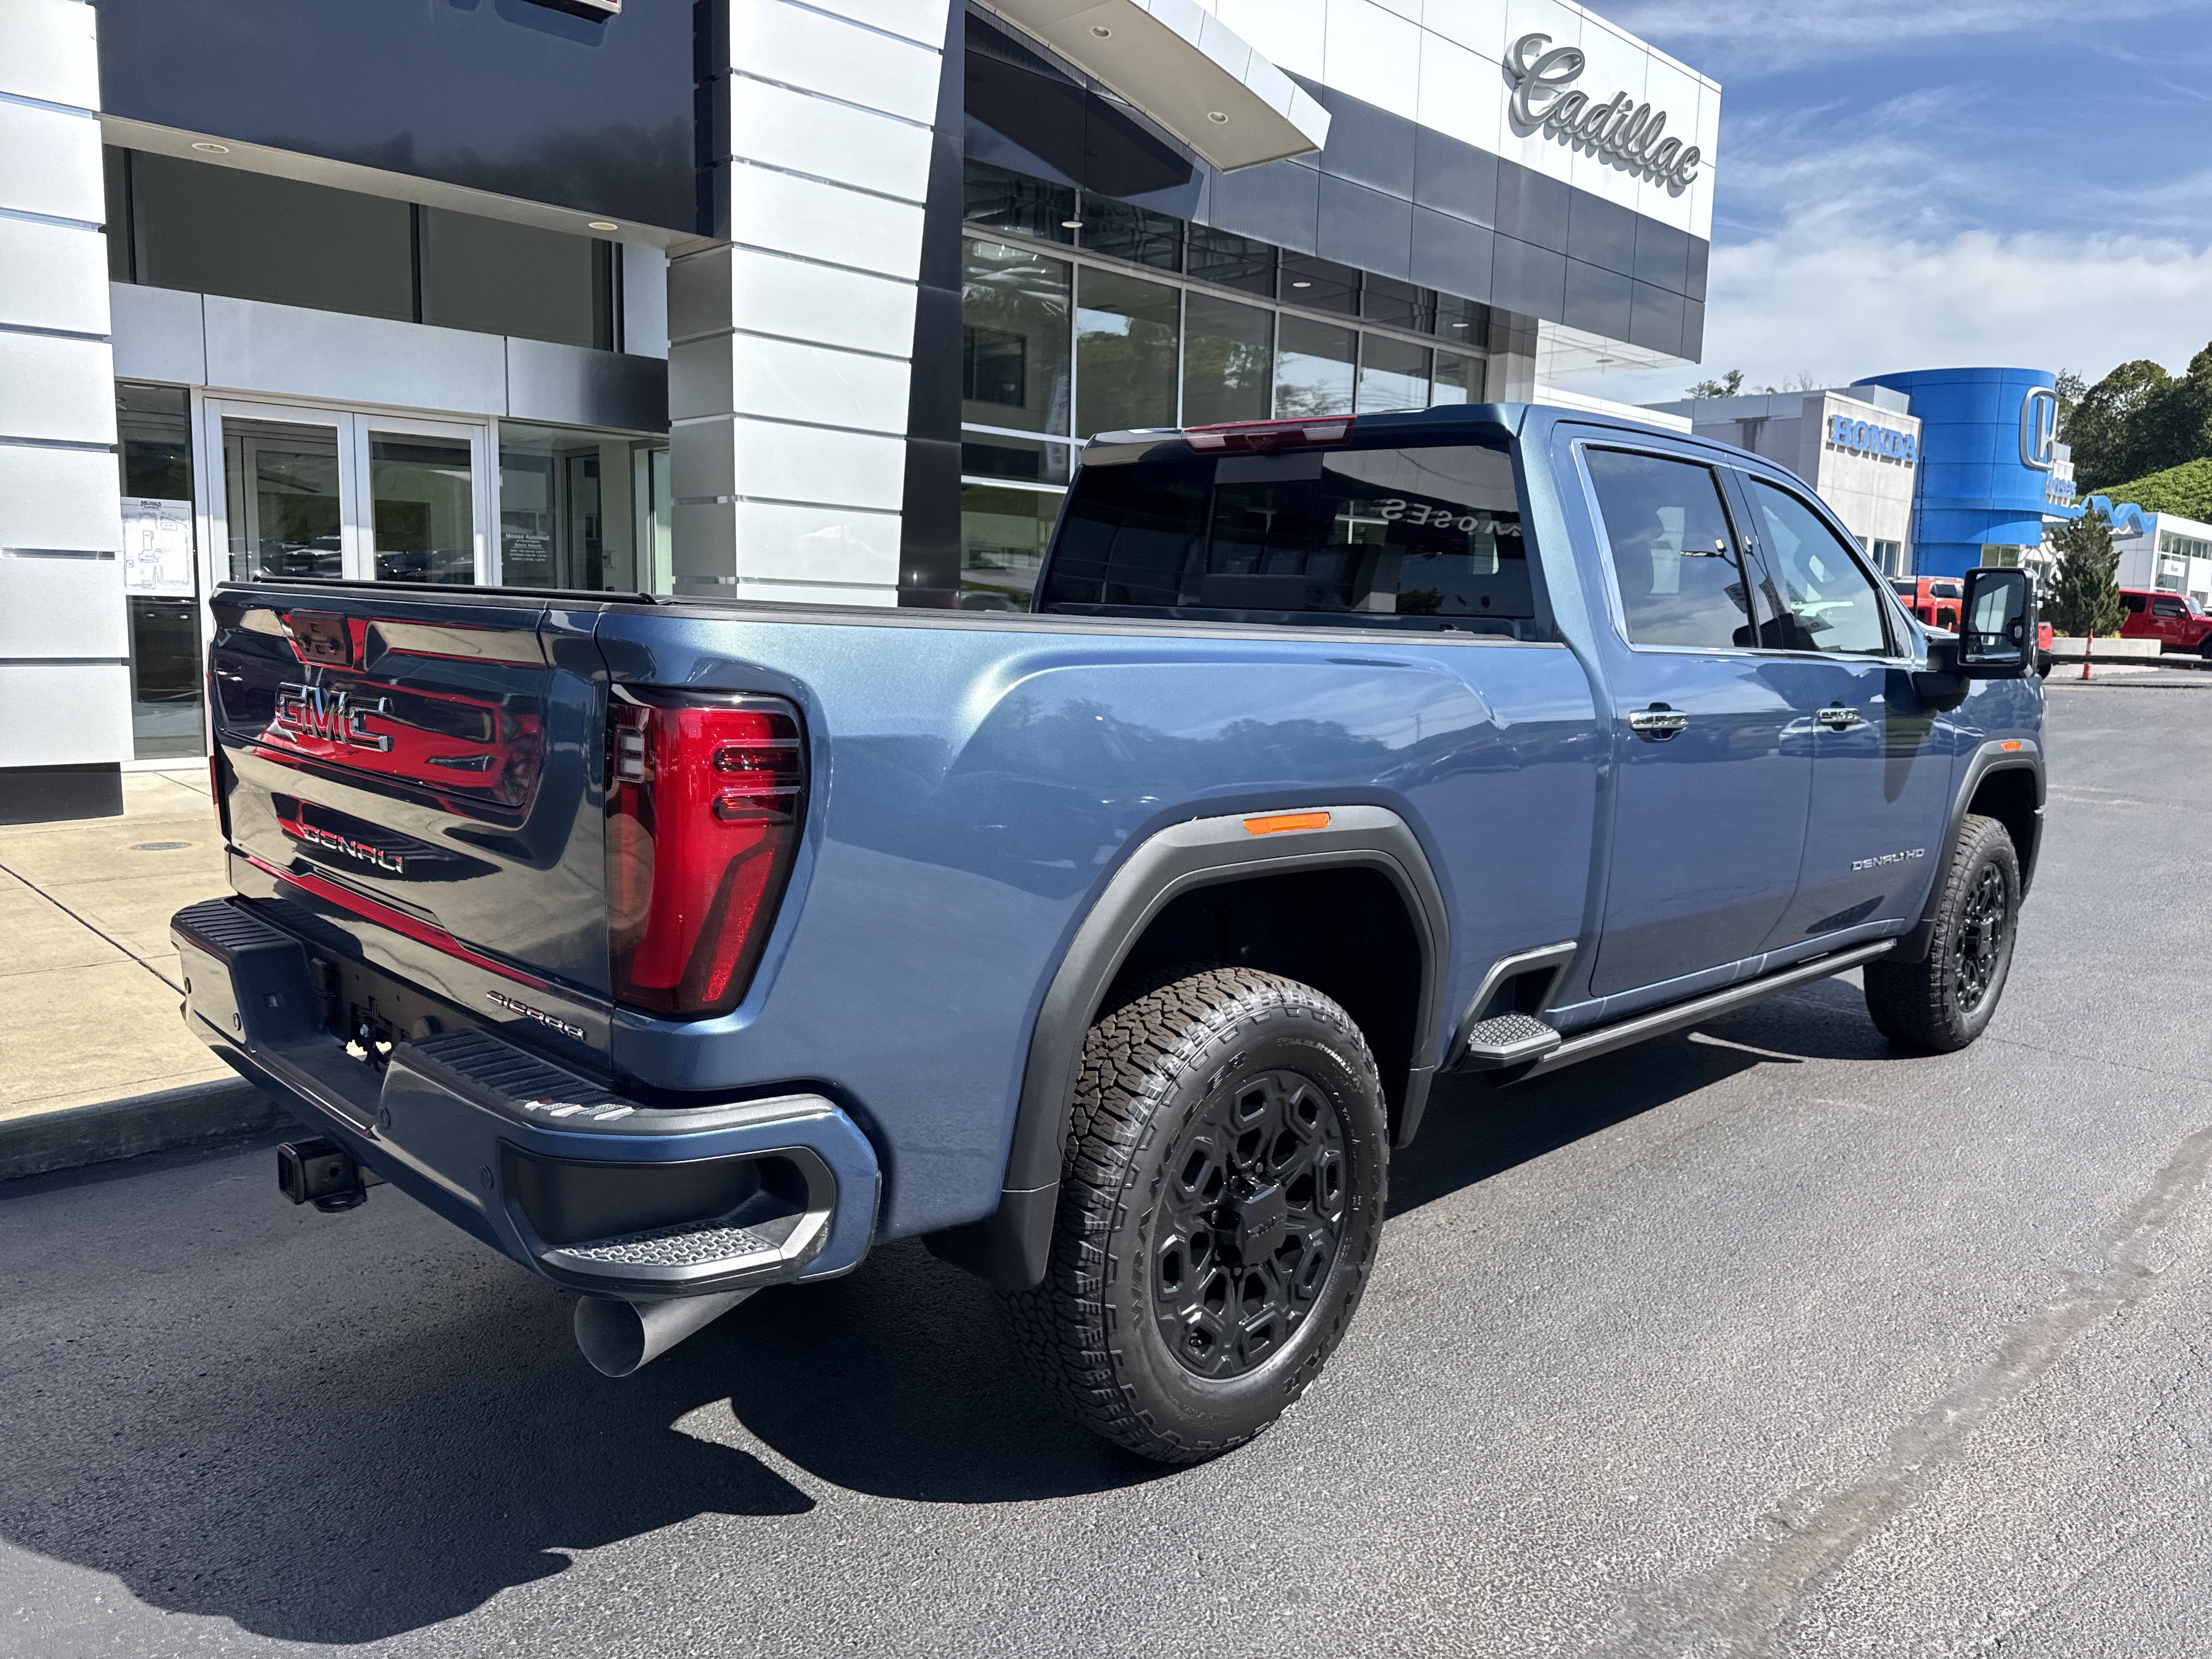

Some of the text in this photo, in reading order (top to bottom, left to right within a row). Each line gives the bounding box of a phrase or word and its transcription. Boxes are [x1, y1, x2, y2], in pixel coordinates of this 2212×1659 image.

[1503, 33, 1700, 185] Cadillac
[1830, 415, 1918, 464] HONDA
[275, 681, 394, 753] GMC
[303, 824, 404, 874] DENALI
[1851, 848, 1925, 871] DENALI HD
[486, 990, 588, 1041] SIERRA
